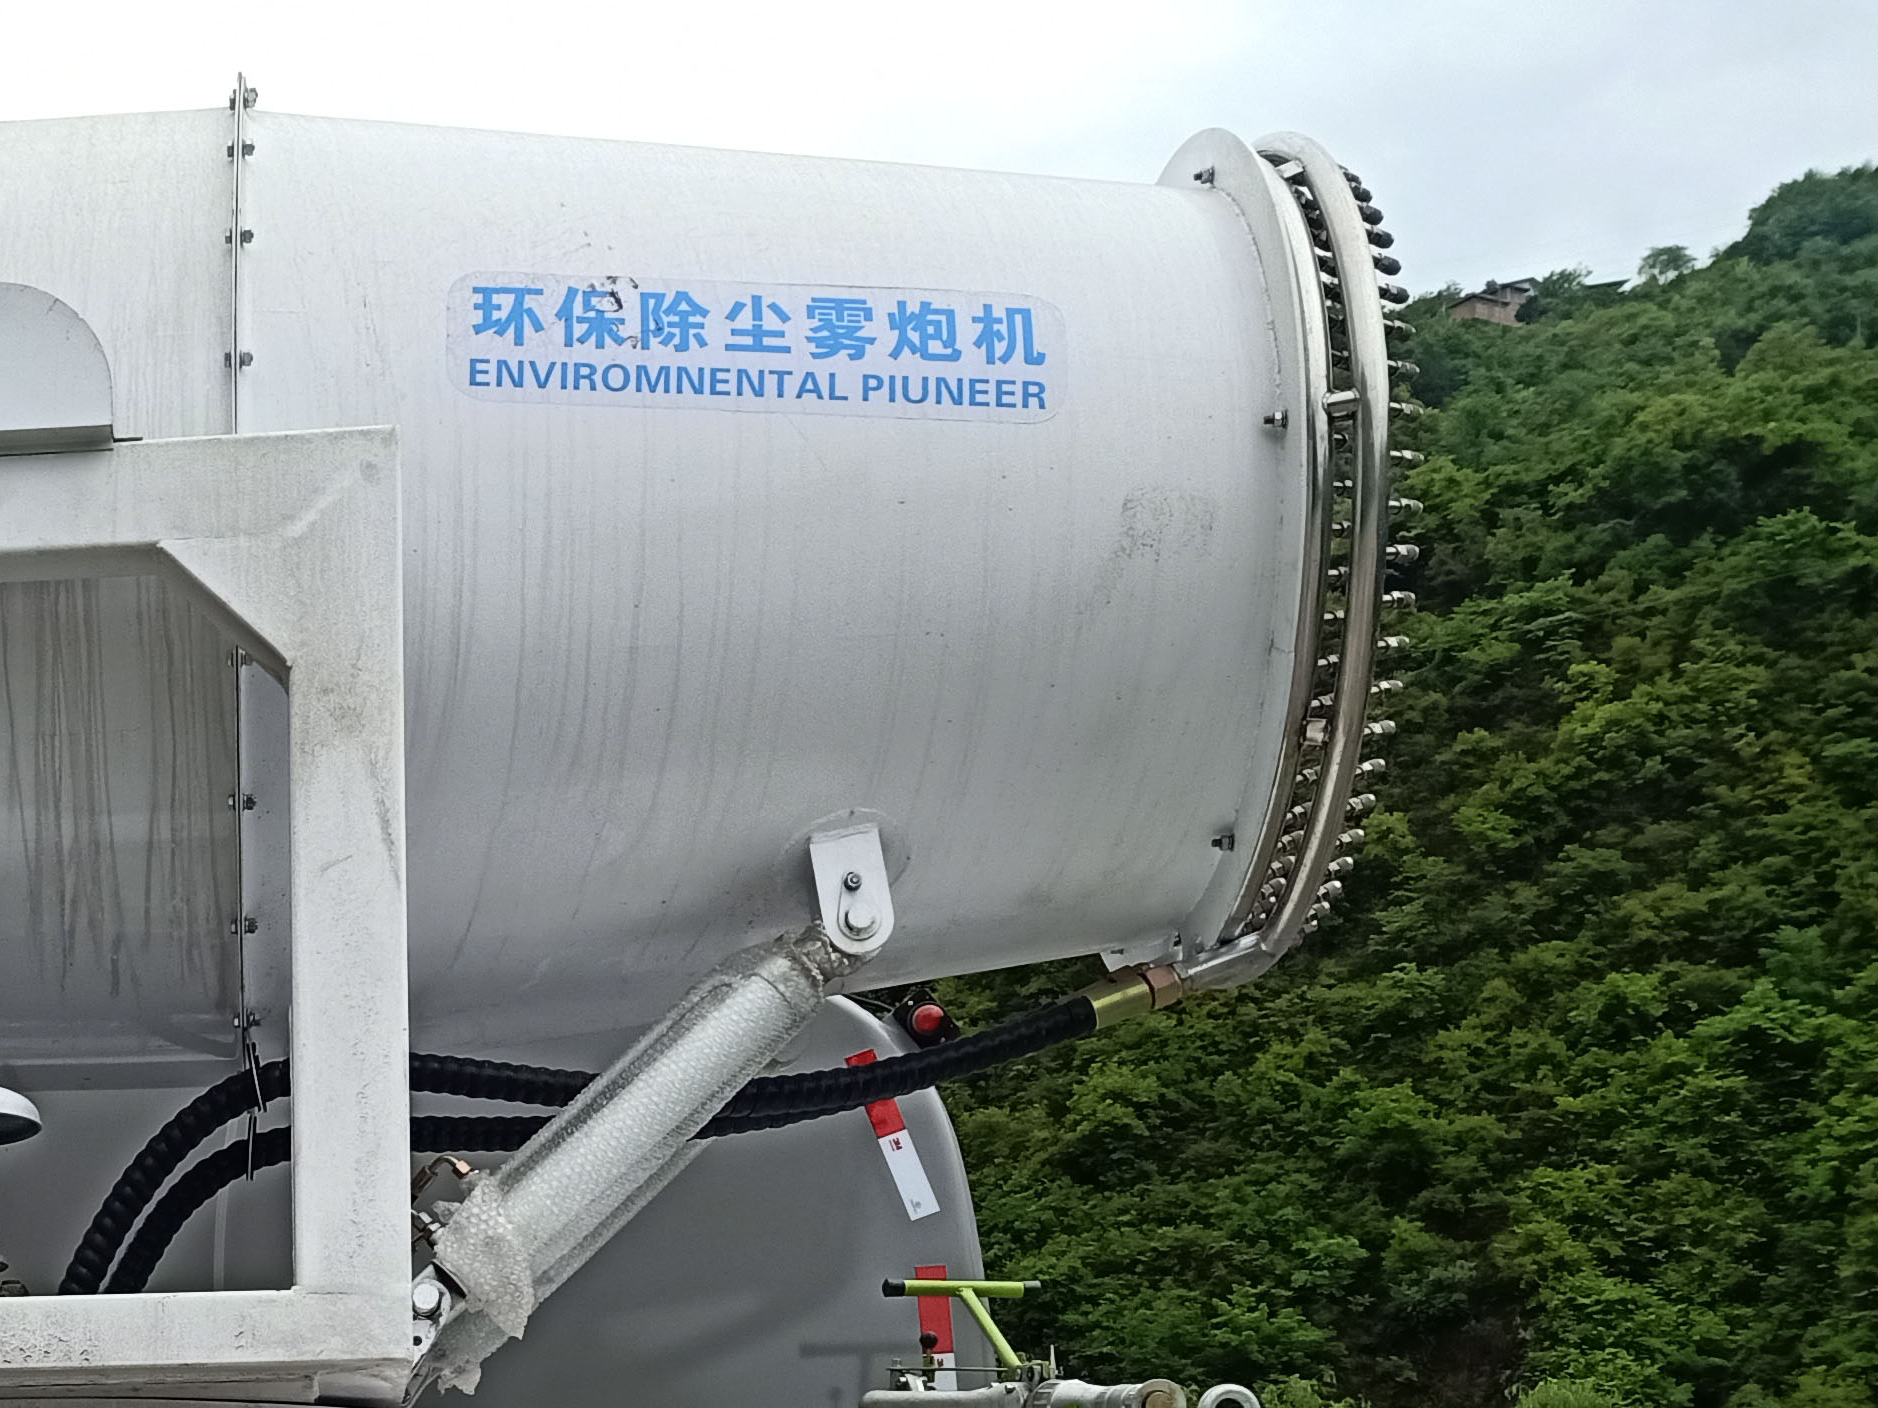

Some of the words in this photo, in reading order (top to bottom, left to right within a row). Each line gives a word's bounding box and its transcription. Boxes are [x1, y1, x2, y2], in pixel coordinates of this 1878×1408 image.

[471, 283, 1047, 366] 环保除尘雾炮机
[468, 358, 850, 402] ENVIROMNENTAL
[860, 373, 1048, 410] PIUNEER
